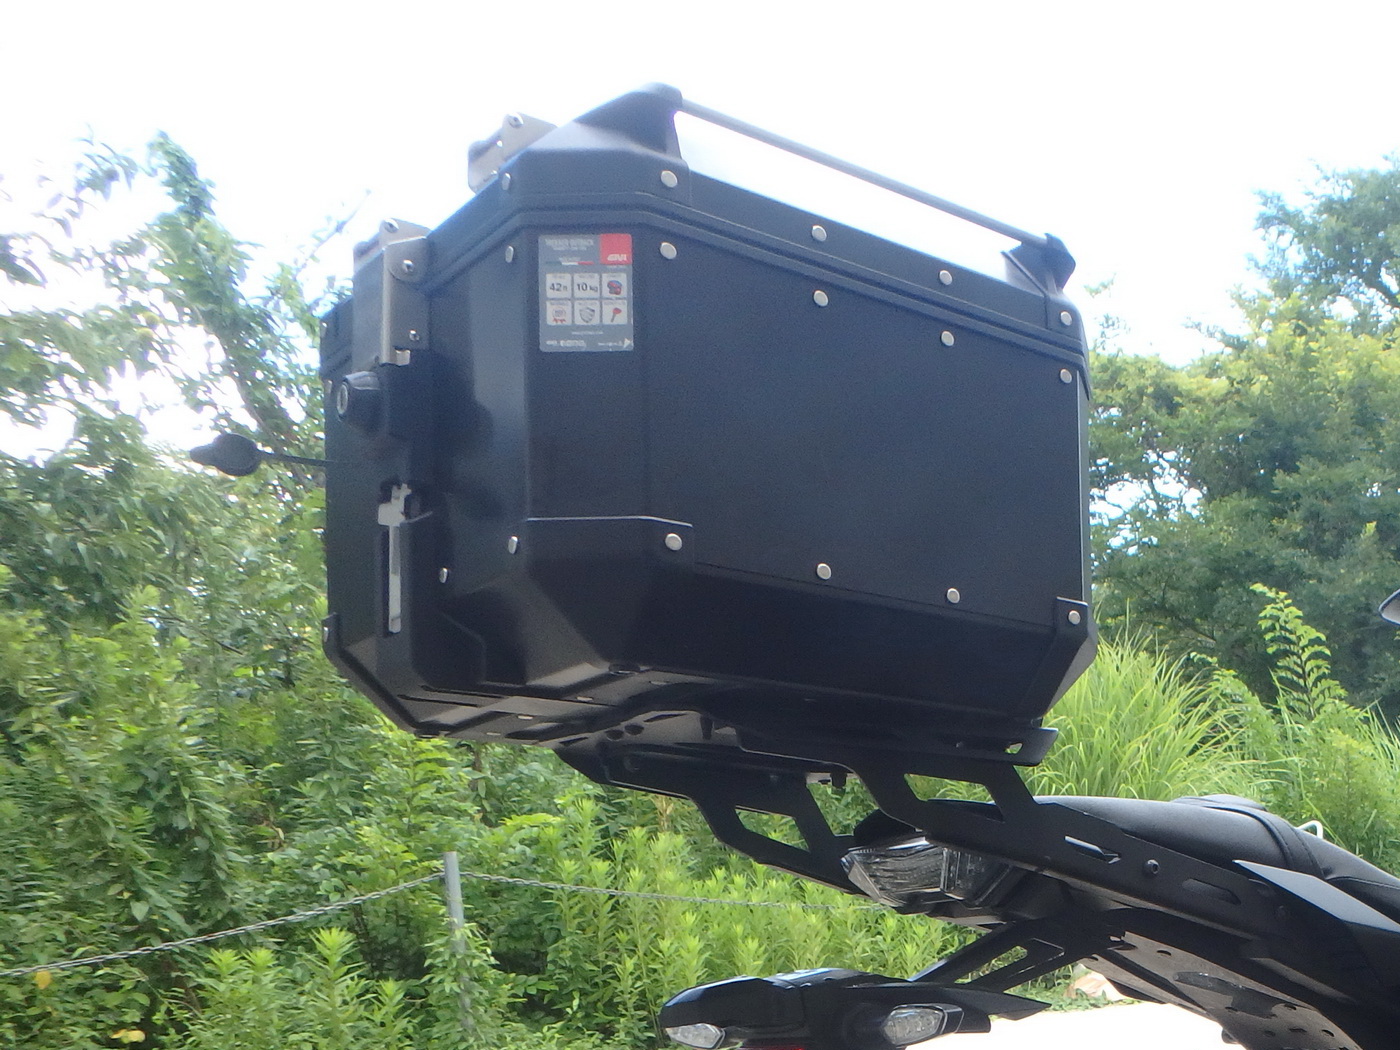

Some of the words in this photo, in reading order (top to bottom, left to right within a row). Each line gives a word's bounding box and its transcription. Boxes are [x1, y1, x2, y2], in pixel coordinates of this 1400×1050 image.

[607, 253, 627, 261] GIVI
[549, 282, 562, 292] 42
[576, 282, 588, 292] 10
